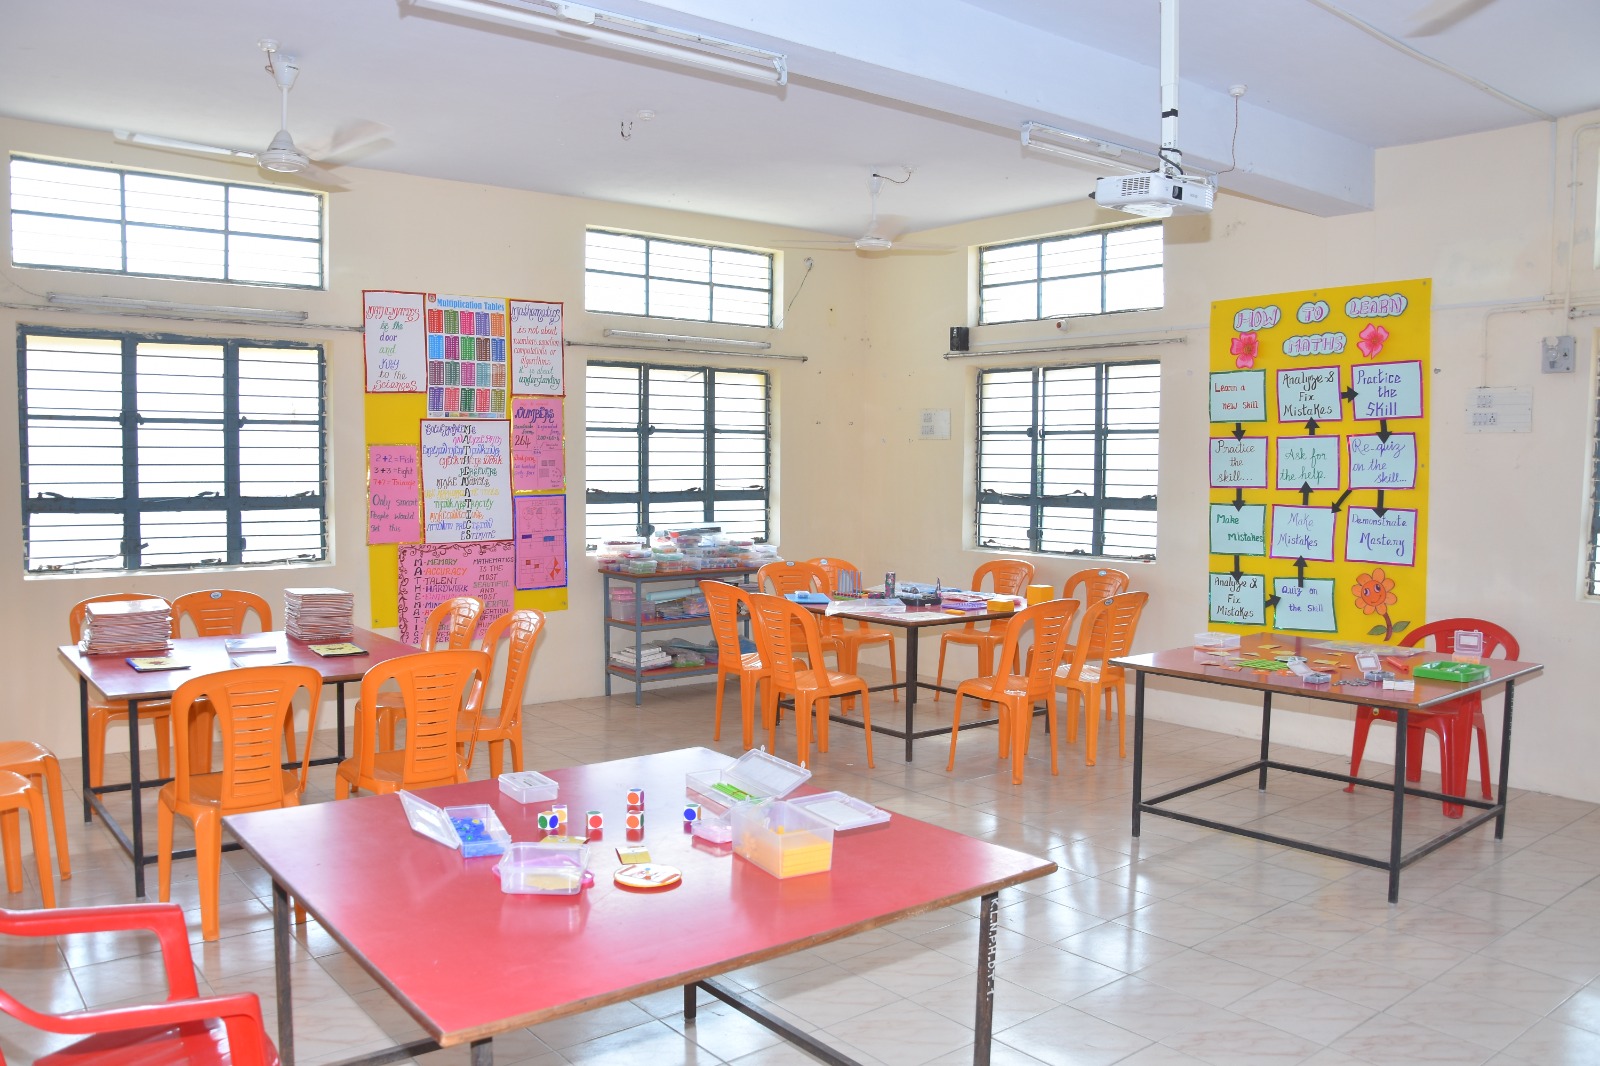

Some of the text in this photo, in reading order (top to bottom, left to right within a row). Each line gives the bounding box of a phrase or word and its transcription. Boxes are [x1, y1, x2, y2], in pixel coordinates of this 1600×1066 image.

[437, 298, 505, 311] Multiplication Tables
[1235, 295, 1402, 329] HOW TO LEARN
[392, 320, 403, 331] the
[541, 326, 558, 335] about
[380, 333, 397, 342] door
[379, 344, 396, 356] and
[1287, 335, 1343, 354] MATHS
[394, 371, 407, 380] the
[1357, 369, 1402, 385] Practice
[1214, 383, 1238, 393] Learn
[1378, 386, 1397, 398] the
[1299, 392, 1314, 401] Fix
[1222, 402, 1238, 410] new
[515, 435, 531, 449] 264
[1215, 440, 1255, 453] Practice
[1352, 438, 1406, 459] Re-quiz
[400, 455, 414, 464] Fish
[1229, 457, 1243, 467] the
[1285, 447, 1326, 468] Ask for
[1352, 458, 1387, 472] on the
[1280, 468, 1295, 482] the
[372, 494, 391, 509] Only
[1216, 514, 1239, 525] Make
[473, 557, 515, 565] MATHEMATICS
[425, 567, 467, 575] ACCURACY
[1227, 593, 1241, 604] Fix
[1289, 603, 1302, 612] the
